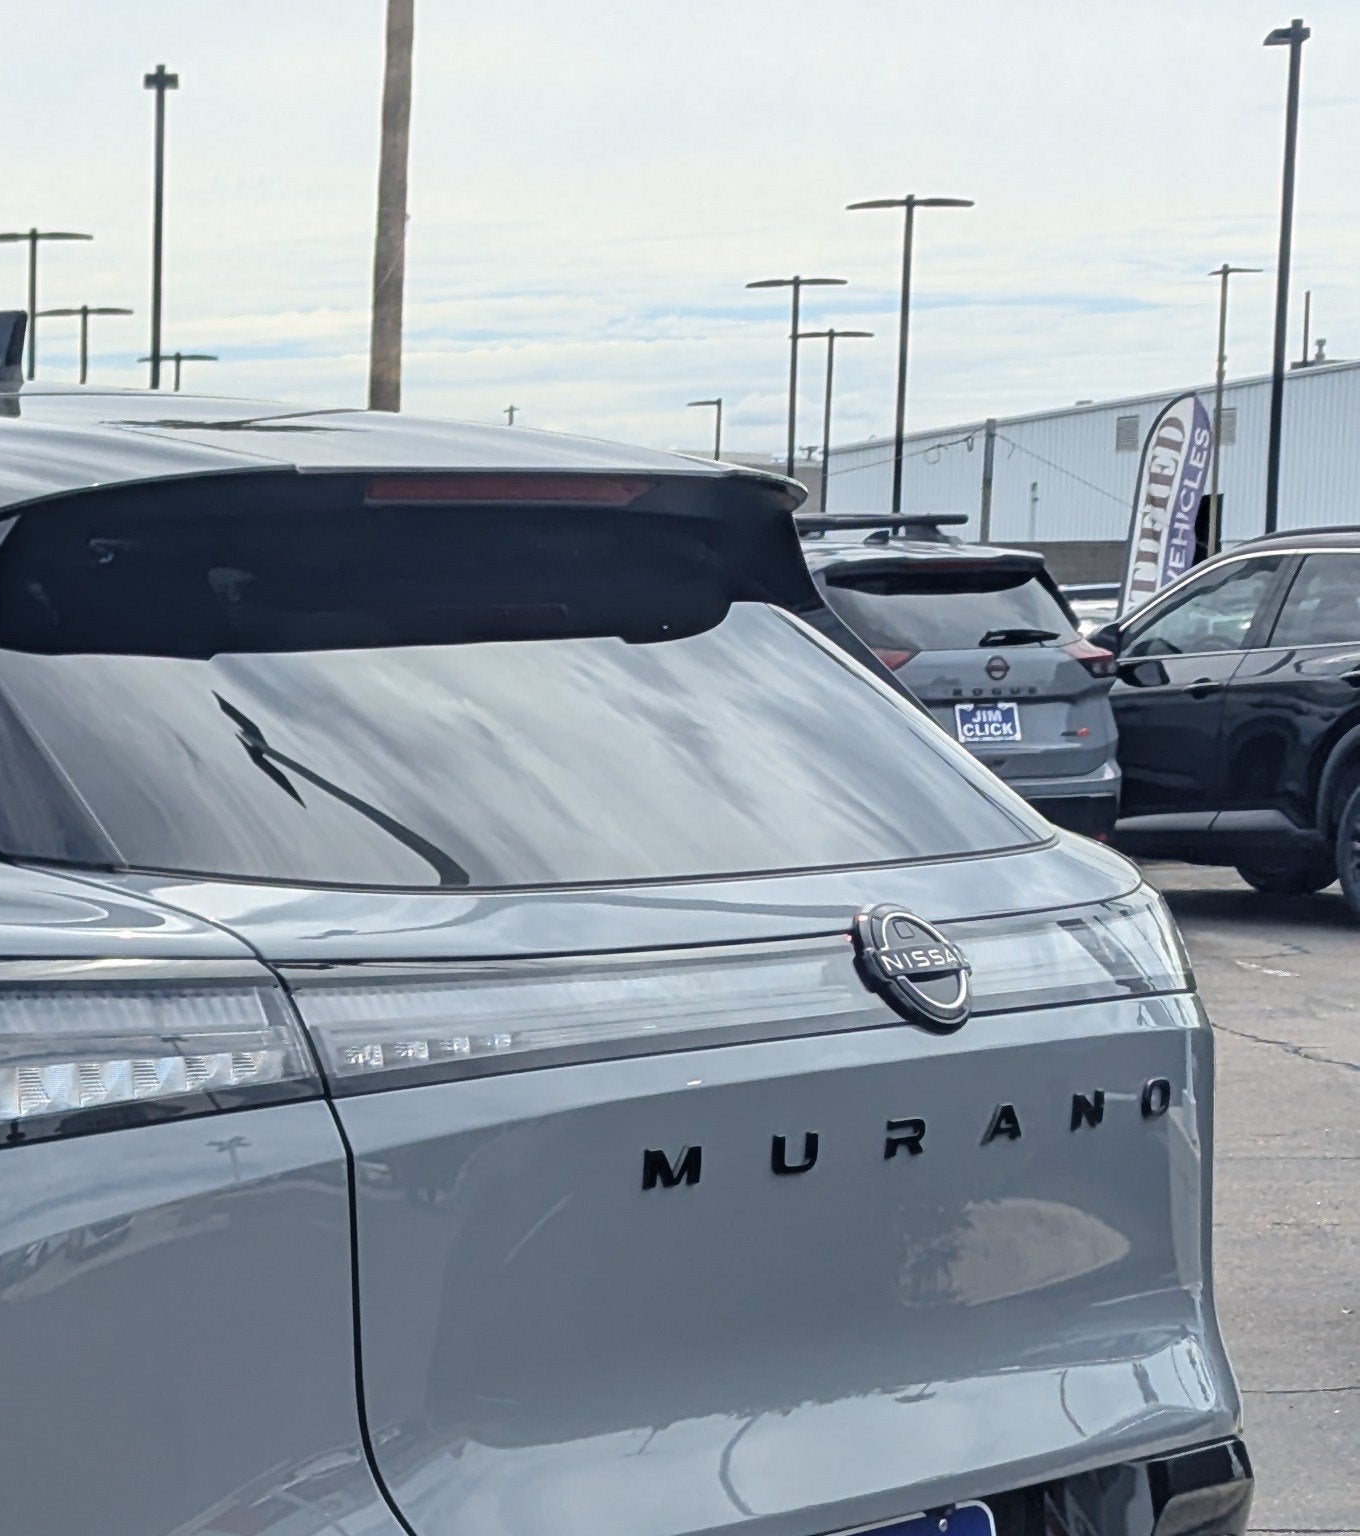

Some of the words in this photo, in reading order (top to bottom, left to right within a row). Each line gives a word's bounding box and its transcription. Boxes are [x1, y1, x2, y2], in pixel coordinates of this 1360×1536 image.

[952, 686, 1038, 697] ROGUE
[971, 709, 1002, 723] JIM
[962, 722, 1014, 737] CLICK
[641, 1076, 1172, 1191] MURANO
